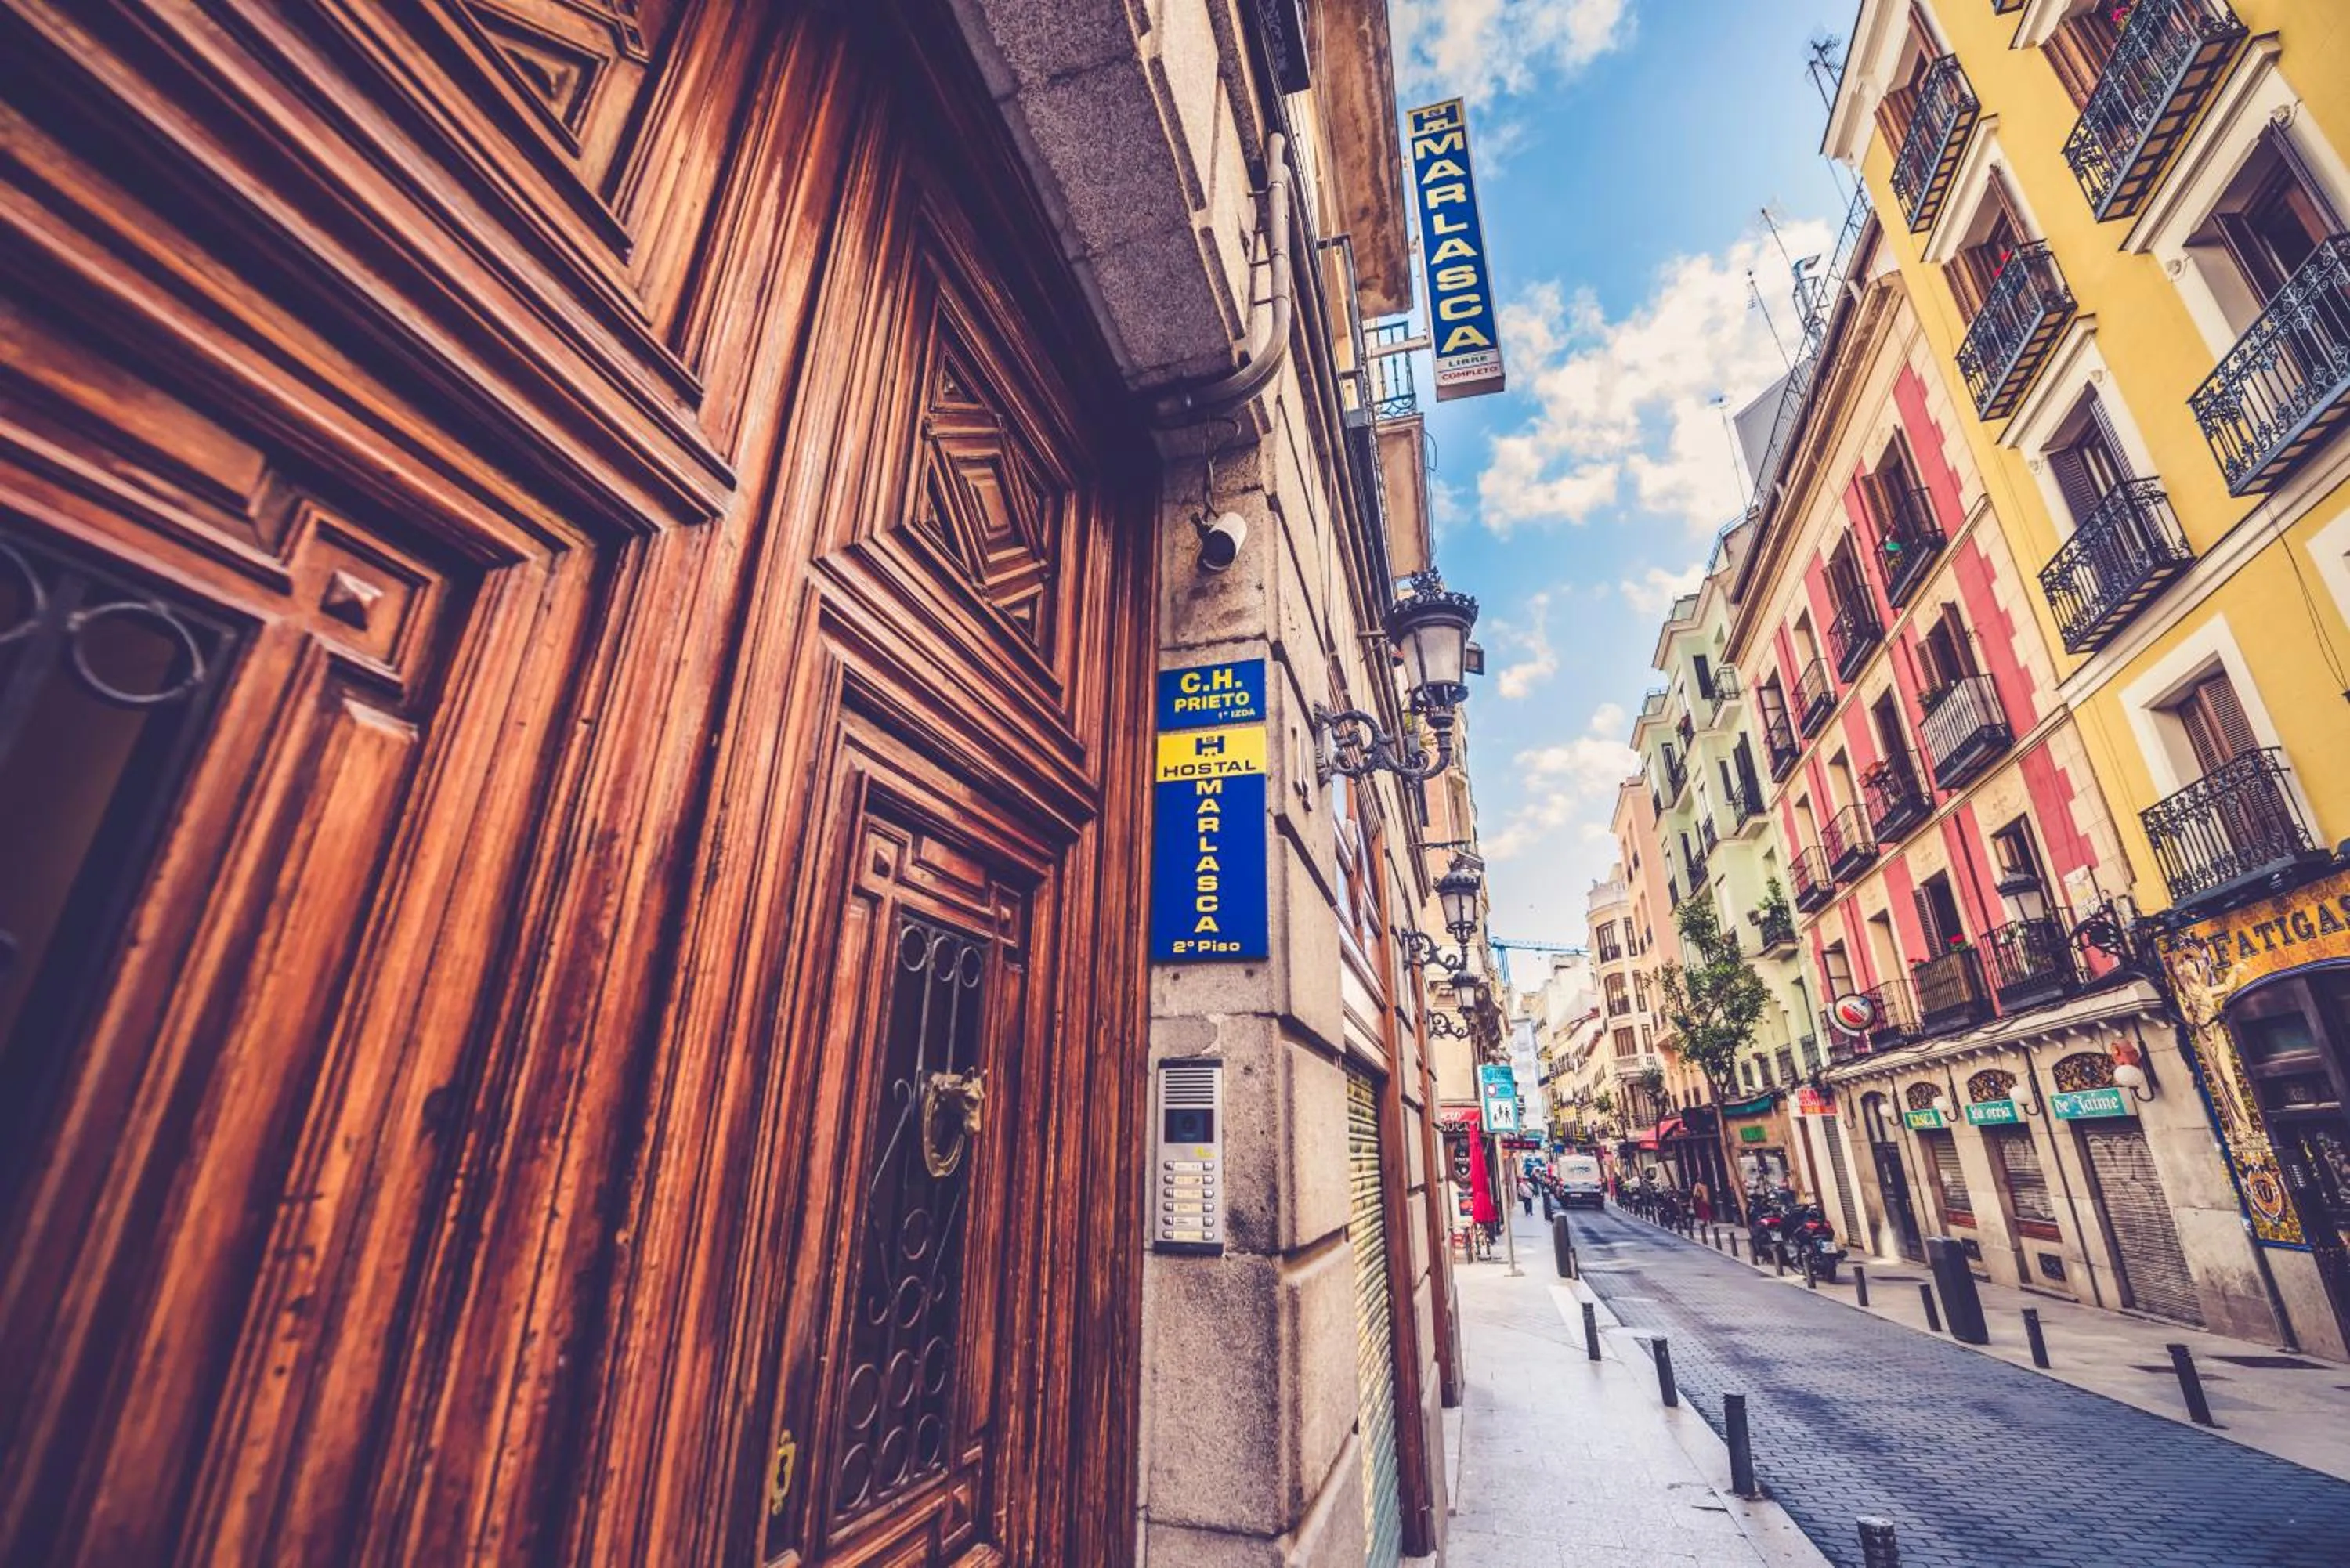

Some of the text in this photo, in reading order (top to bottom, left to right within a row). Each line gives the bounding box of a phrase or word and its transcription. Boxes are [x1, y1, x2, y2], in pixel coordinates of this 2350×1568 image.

[1415, 132, 1491, 353] MARLASCA
[1448, 356, 1488, 367] LIBRE
[1441, 366, 1498, 380] COMPLETO
[1180, 668, 1243, 694] C.H.
[1174, 692, 1250, 712] PRIETO
[1231, 708, 1255, 718] IZDA
[1163, 760, 1257, 777] HOSTAL
[1195, 779, 1223, 933] MARLASCA
[1198, 940, 1240, 952] Piso
